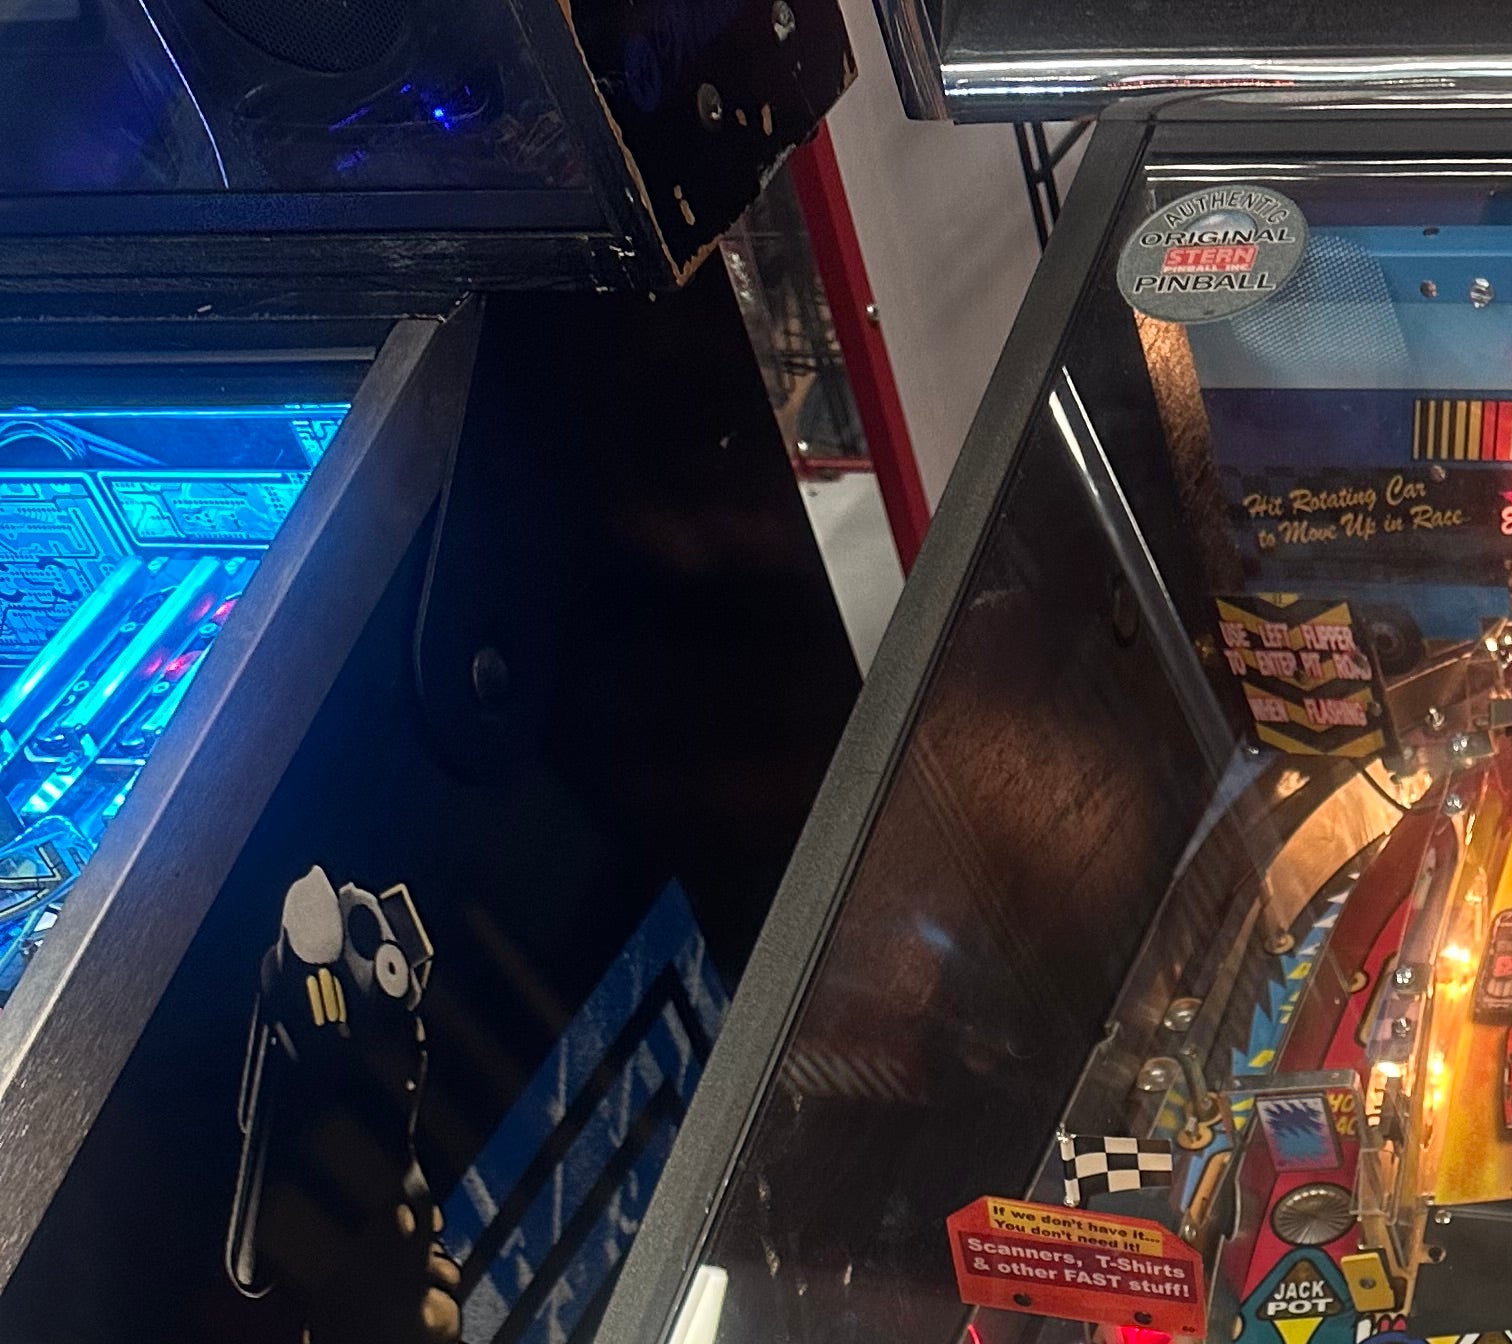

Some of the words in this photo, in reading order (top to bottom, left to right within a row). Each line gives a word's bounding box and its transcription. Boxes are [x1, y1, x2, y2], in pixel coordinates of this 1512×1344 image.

[1164, 191, 1288, 228] AUTHENTIC
[1139, 229, 1295, 247] ORIGINAL
[1165, 247, 1256, 266] STERN
[1133, 272, 1276, 294] PINBALL
[1242, 492, 1284, 519] Hit
[1288, 483, 1378, 512] Rotating
[1385, 474, 1428, 502] Car
[1258, 528, 1277, 548] to
[1277, 520, 1338, 545] Move
[1341, 512, 1377, 542] Up
[1384, 513, 1403, 534] in
[1410, 508, 1466, 531] Race
[992, 1205, 1006, 1219] If
[1010, 1210, 1036, 1223] we
[1039, 1210, 1085, 1232] don't
[1087, 1218, 1129, 1238] have
[993, 1219, 1026, 1234] You
[1029, 1223, 1074, 1242] don't
[1077, 1234, 1120, 1251] need
[967, 1237, 1083, 1268] Scanners,
[1095, 1253, 1186, 1279] T-Shirts
[972, 1255, 992, 1271] &
[997, 1260, 1062, 1281] other
[1063, 1267, 1122, 1290] FAST
[1128, 1277, 1191, 1299] stuff!
[1273, 1279, 1325, 1300] JACK
[1266, 1297, 1334, 1316] POT
